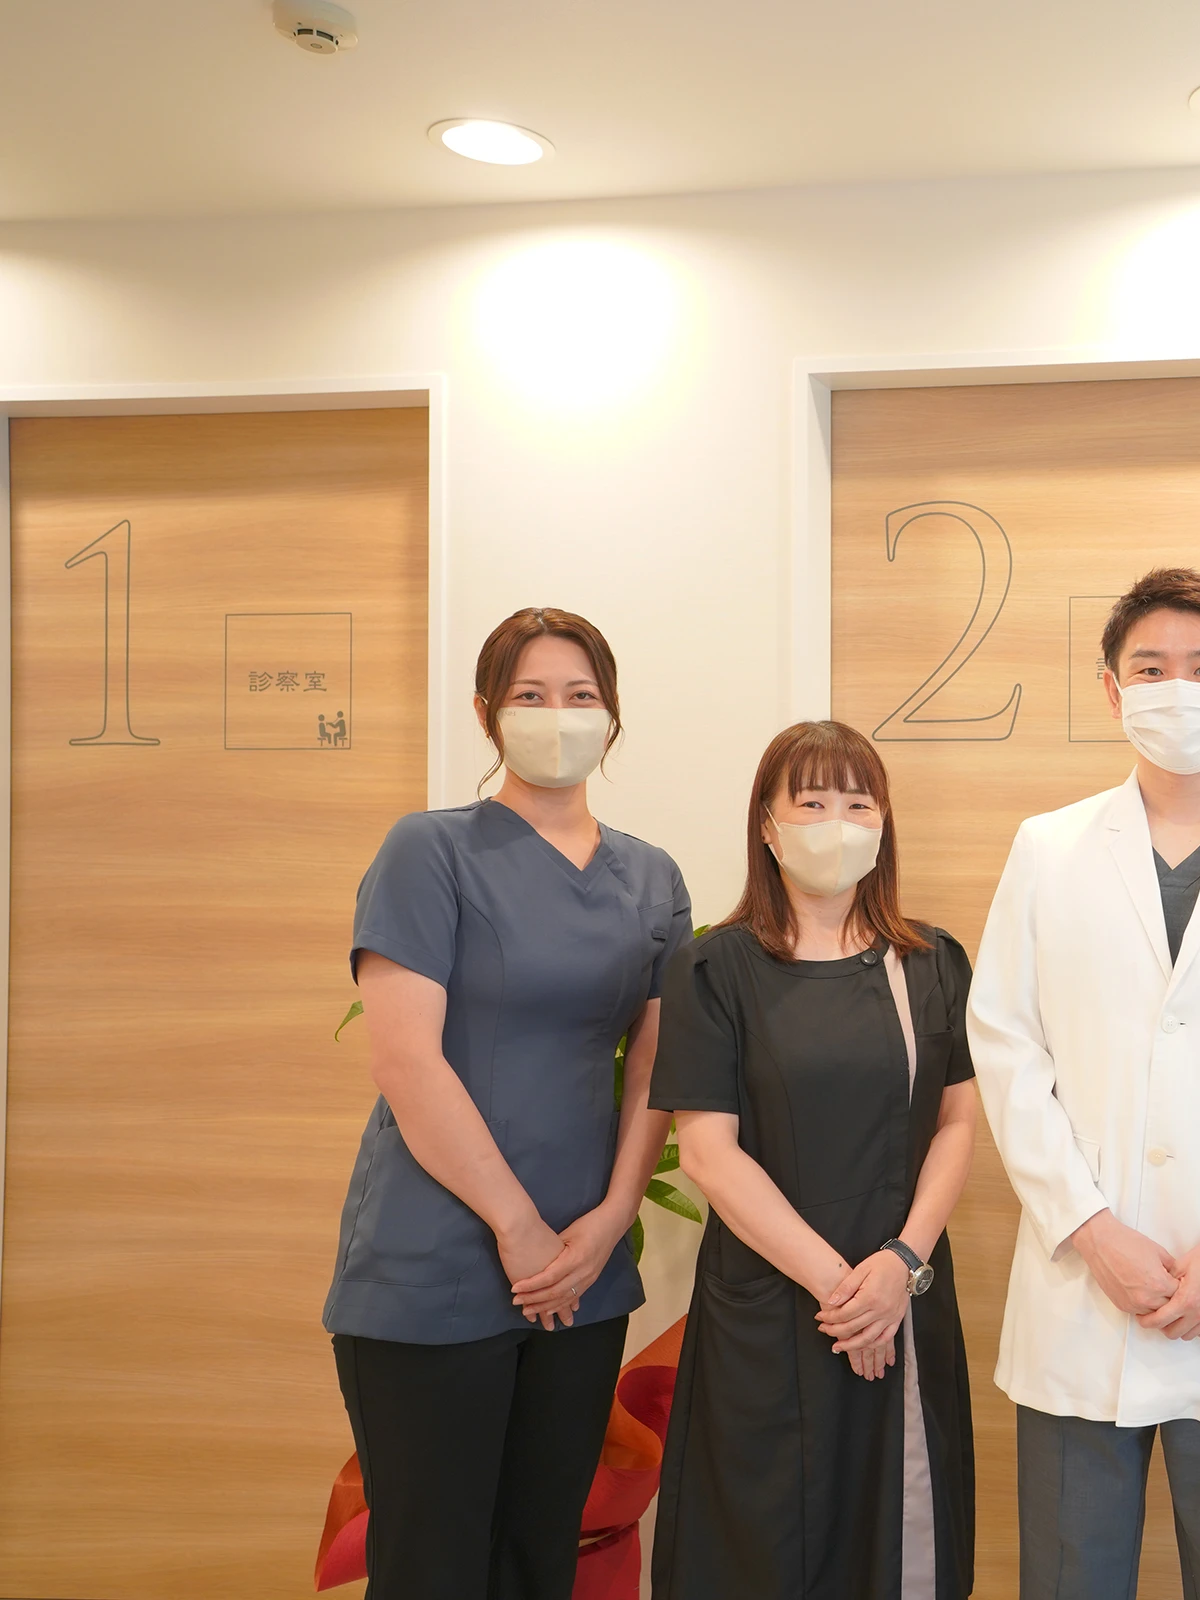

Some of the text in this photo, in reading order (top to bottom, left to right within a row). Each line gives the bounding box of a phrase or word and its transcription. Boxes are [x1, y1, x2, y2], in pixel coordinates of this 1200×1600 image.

[65, 519, 161, 746] 1
[248, 670, 327, 692] 診察室
[872, 500, 1022, 741] 2
